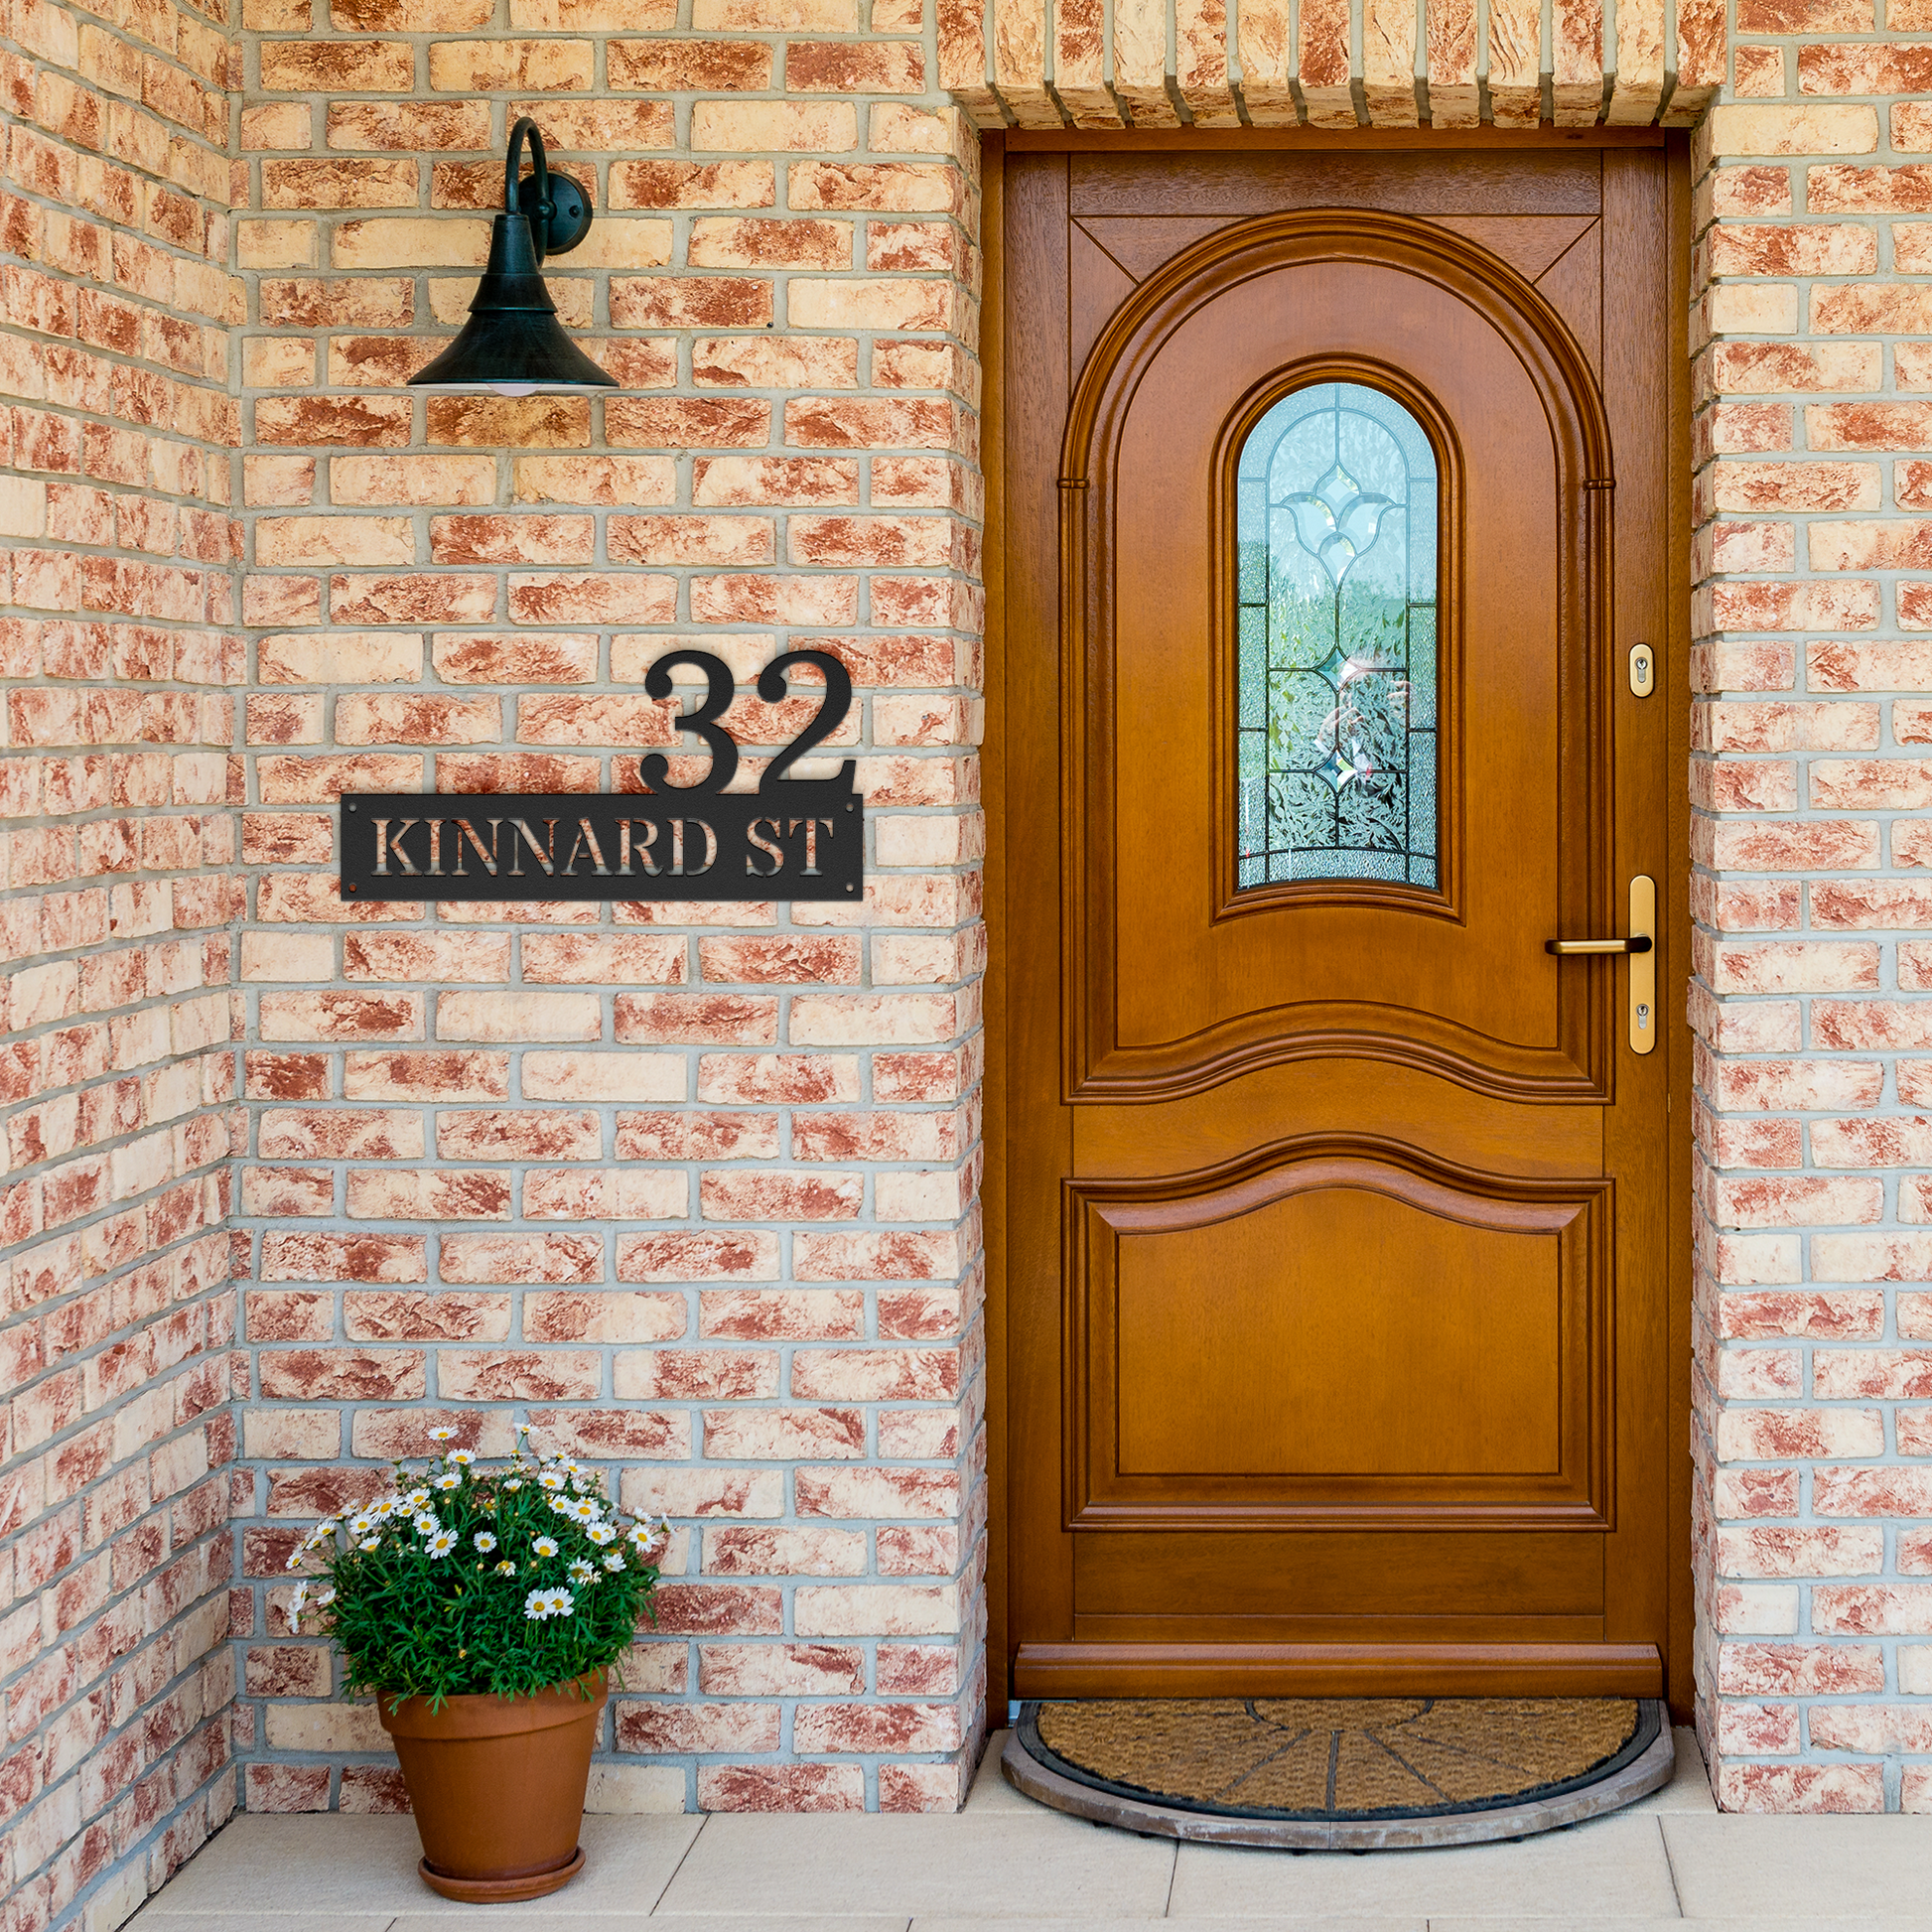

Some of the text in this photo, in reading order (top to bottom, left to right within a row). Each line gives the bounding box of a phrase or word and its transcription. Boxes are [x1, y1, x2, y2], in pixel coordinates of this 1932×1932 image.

[639, 649, 857, 795] 32
[369, 817, 835, 878] KINNARD ST
